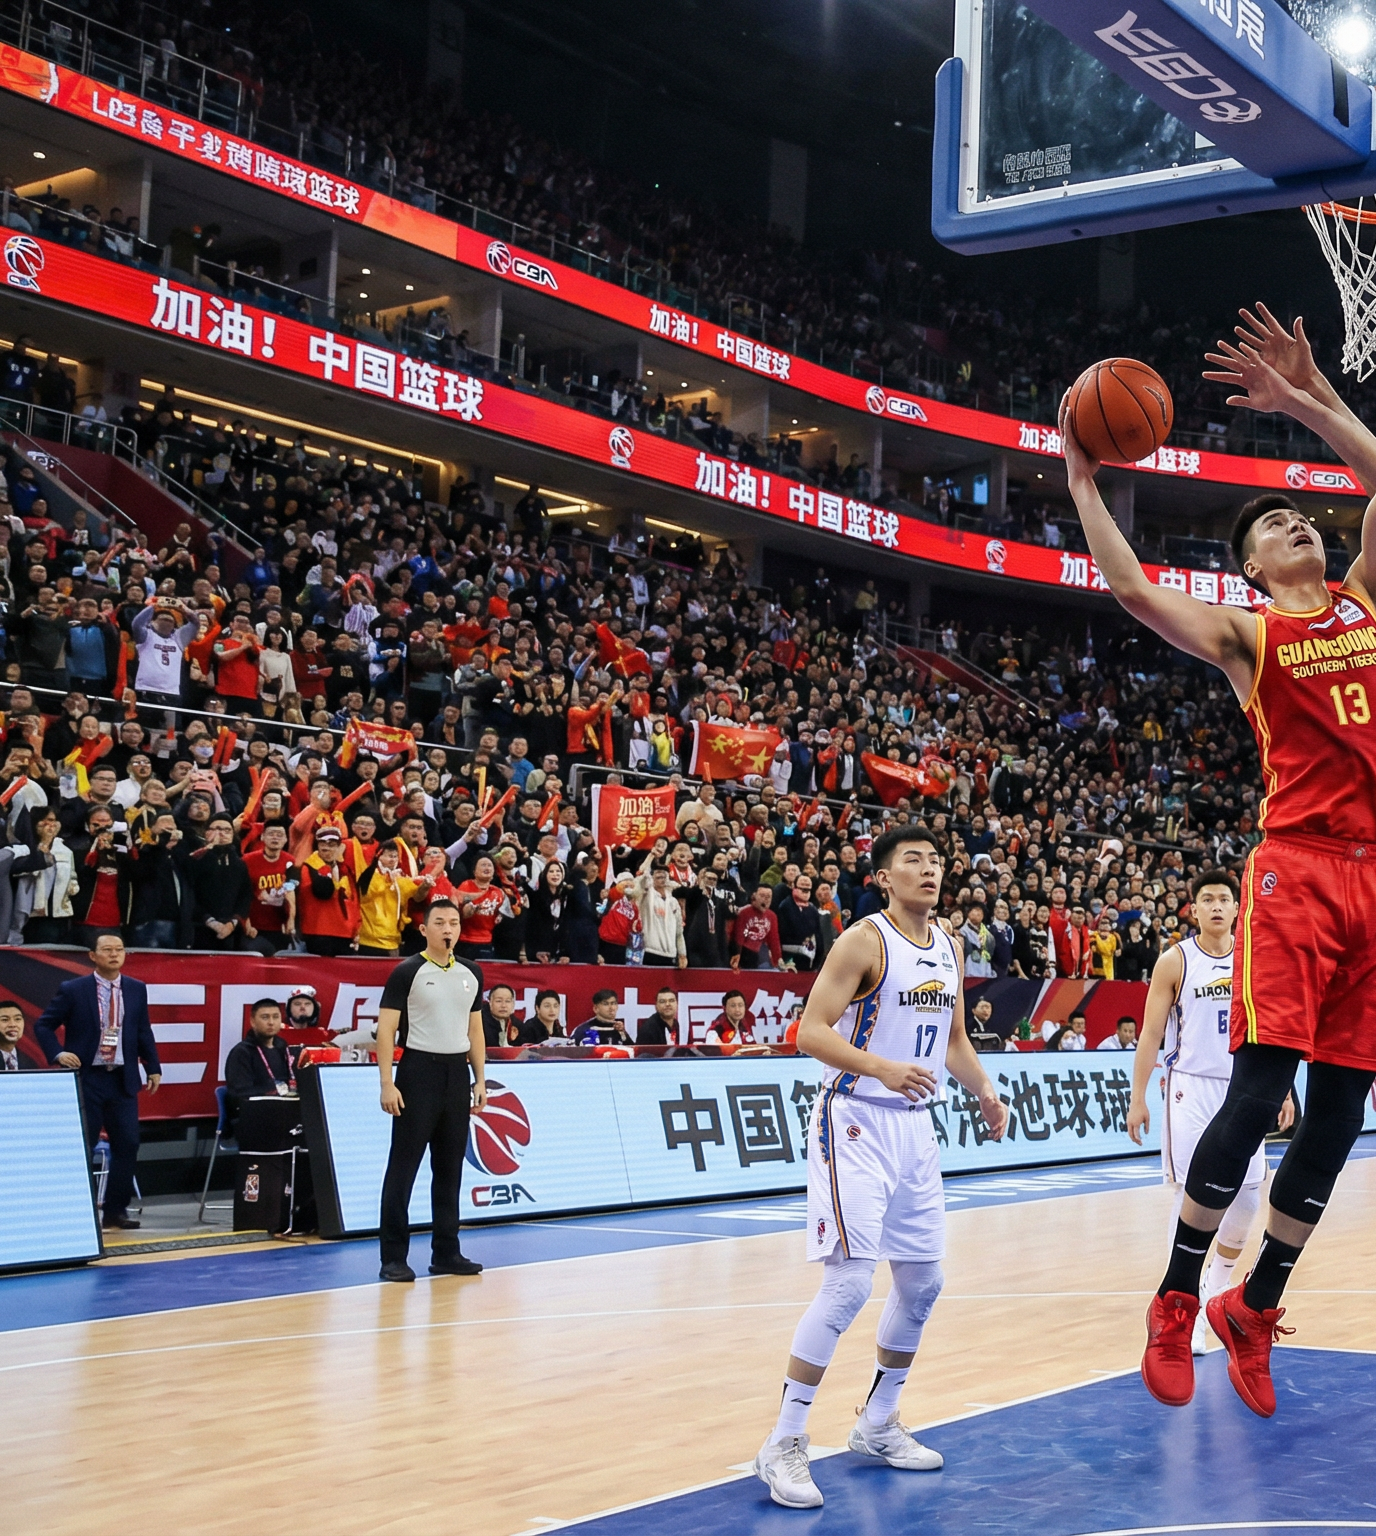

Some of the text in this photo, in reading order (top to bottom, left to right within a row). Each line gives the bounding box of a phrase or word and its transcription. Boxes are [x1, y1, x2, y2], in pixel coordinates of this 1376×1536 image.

[512, 257, 558, 290] CBA
[150, 277, 485, 422] 加油！ 中国篮球
[650, 304, 790, 380] 加油！ 中国篮球
[696, 452, 900, 548] 加油！ 中国篮球
[1330, 682, 1371, 726] 13
[1194, 985, 1231, 999] LIAON
[914, 1024, 938, 1057] 17
[471, 1183, 536, 1208] CBA
